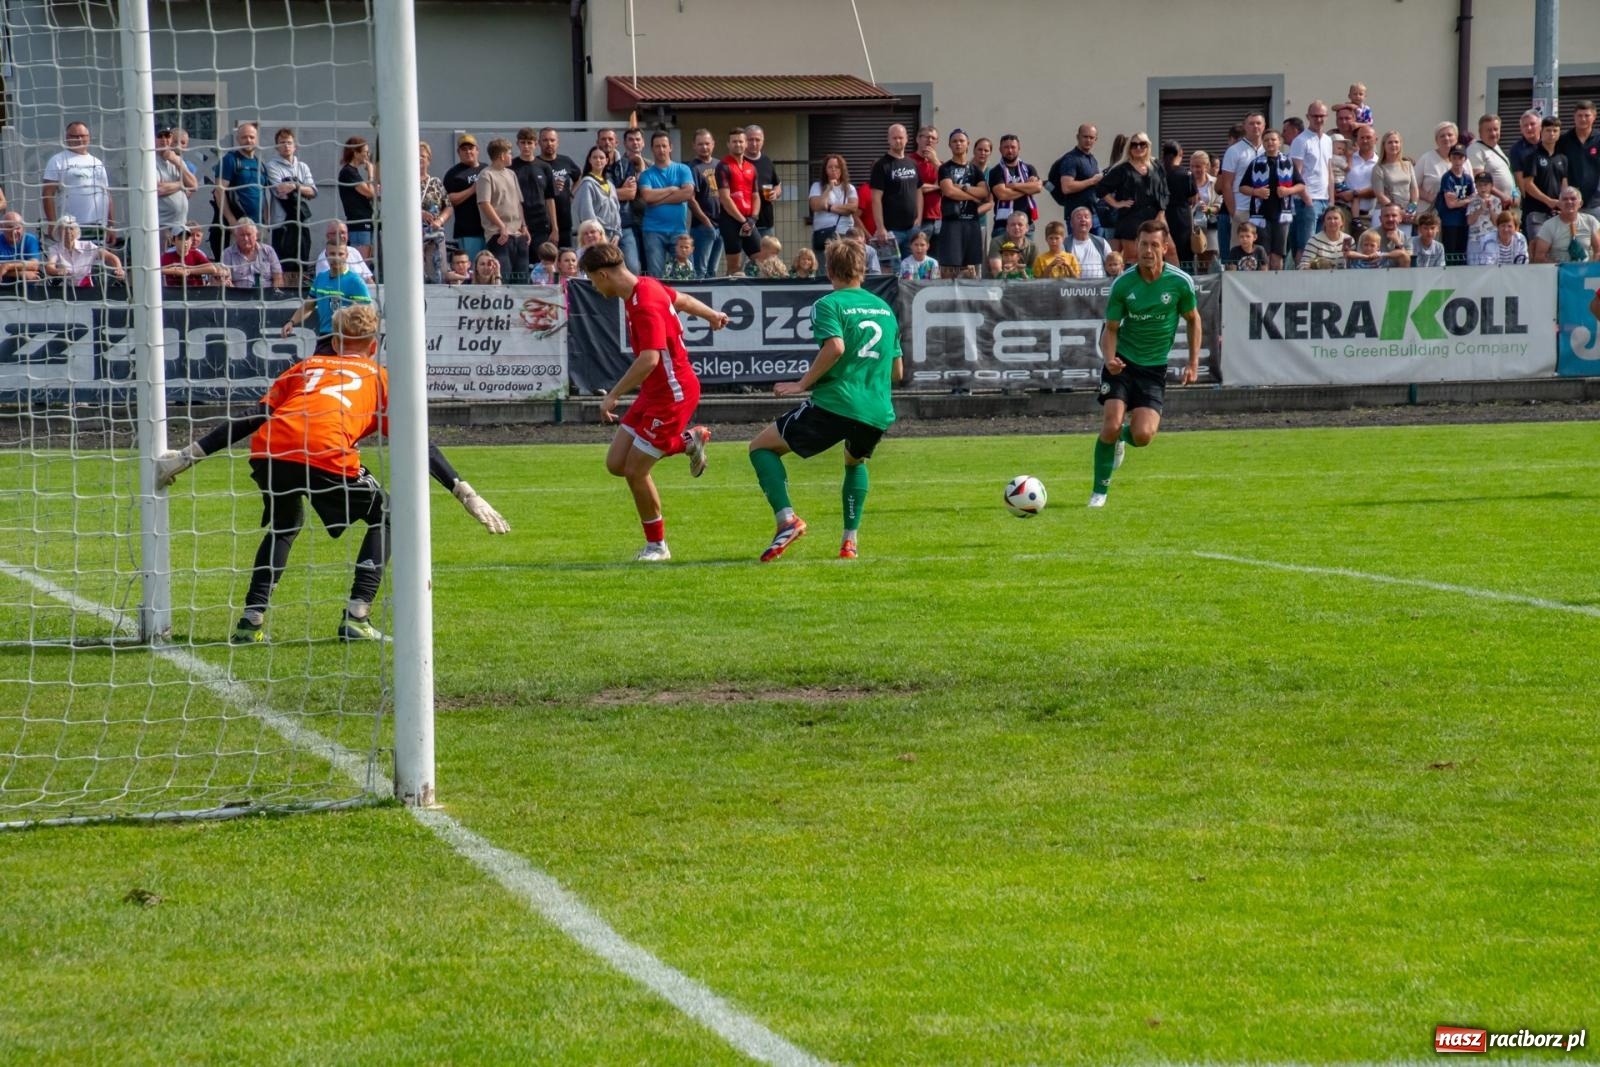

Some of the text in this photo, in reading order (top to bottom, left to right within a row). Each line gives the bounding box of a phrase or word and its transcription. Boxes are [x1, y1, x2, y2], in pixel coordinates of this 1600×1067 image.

[457, 295, 514, 310] Kebab
[1249, 288, 1528, 341] KERAKOLL
[458, 315, 511, 334] Frytki
[458, 336, 502, 354] Lody
[857, 320, 883, 359] 2
[1312, 341, 1528, 359] The GreenBuilding Company
[476, 365, 495, 376] tel.
[496, 365, 510, 376] 32
[511, 365, 531, 376] 729
[532, 365, 546, 376] 69
[547, 365, 562, 376] 69
[304, 367, 363, 408] 12
[478, 382, 534, 393] Ogrodowa
[536, 382, 543, 391] 2
